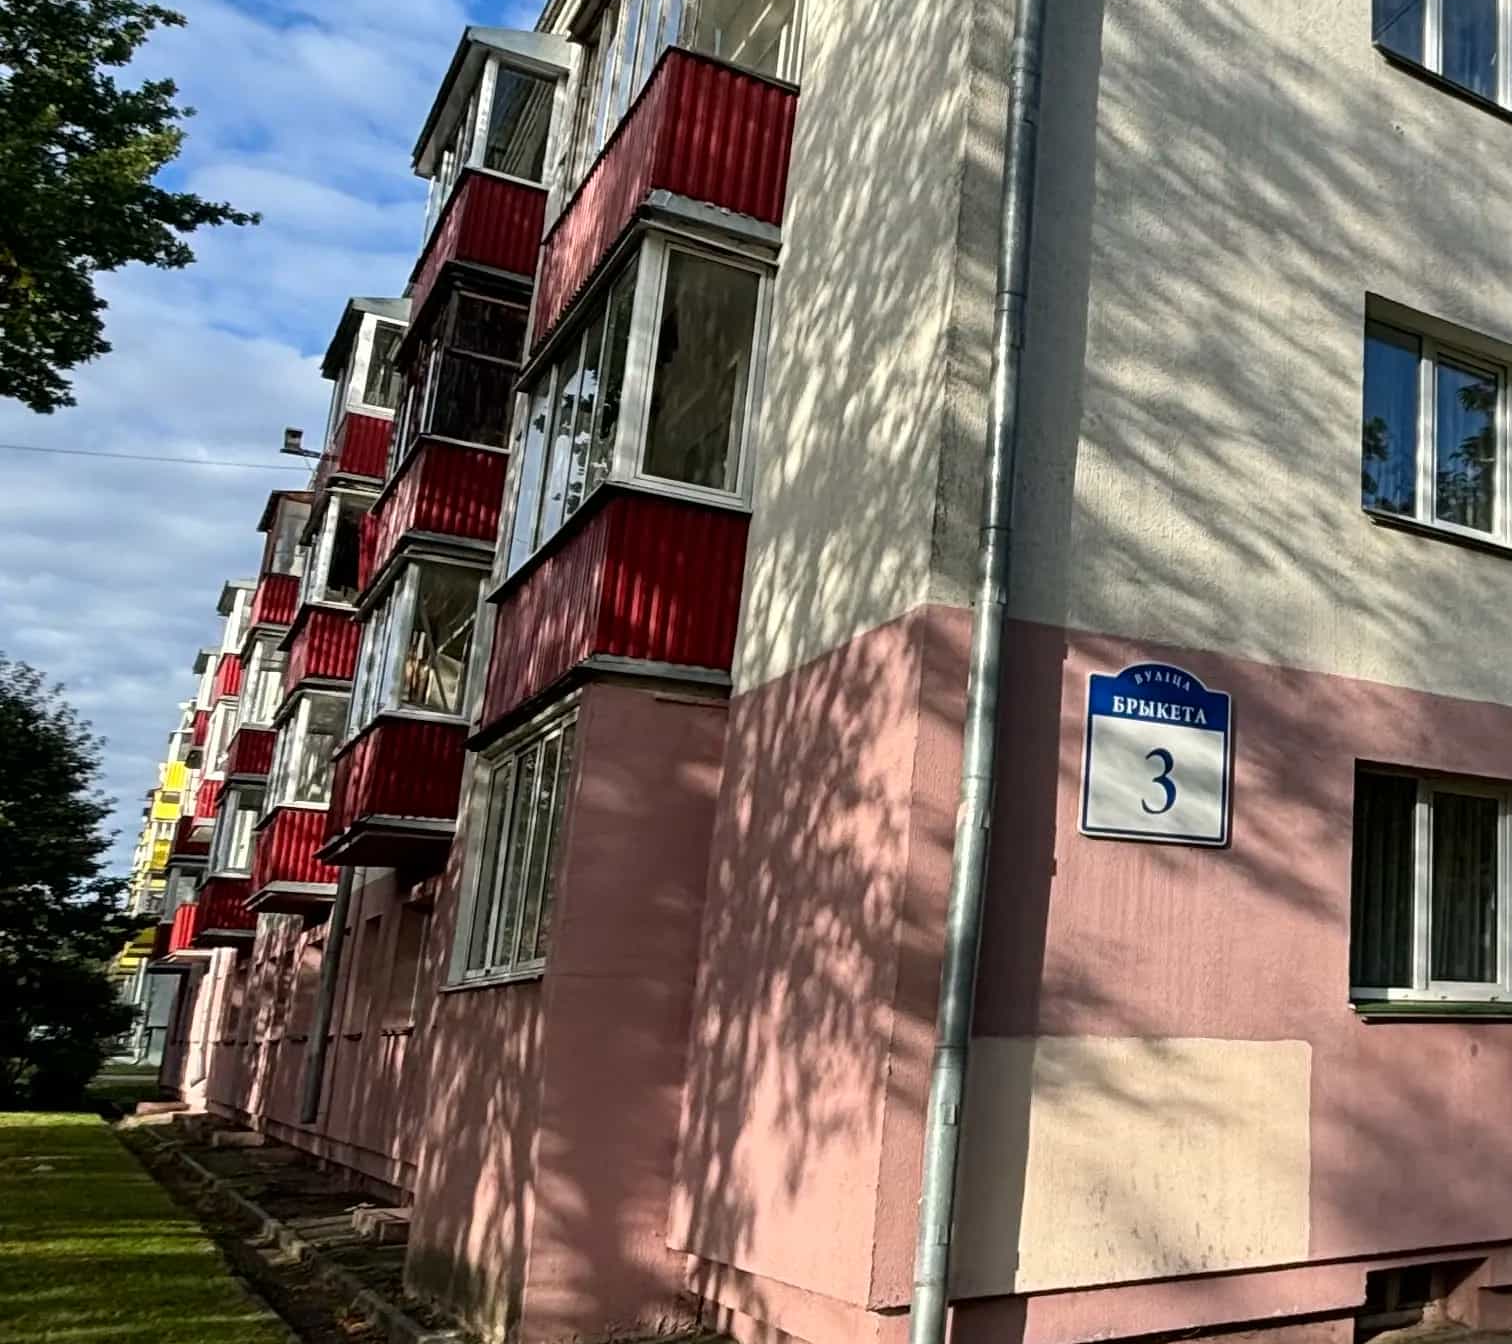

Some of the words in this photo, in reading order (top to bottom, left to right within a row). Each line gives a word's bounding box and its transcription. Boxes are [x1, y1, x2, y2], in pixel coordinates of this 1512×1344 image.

[1134, 670, 1191, 692] ВУЛІЦА
[1112, 695, 1208, 724] БРЫКЕТА
[1141, 747, 1177, 814] 3
